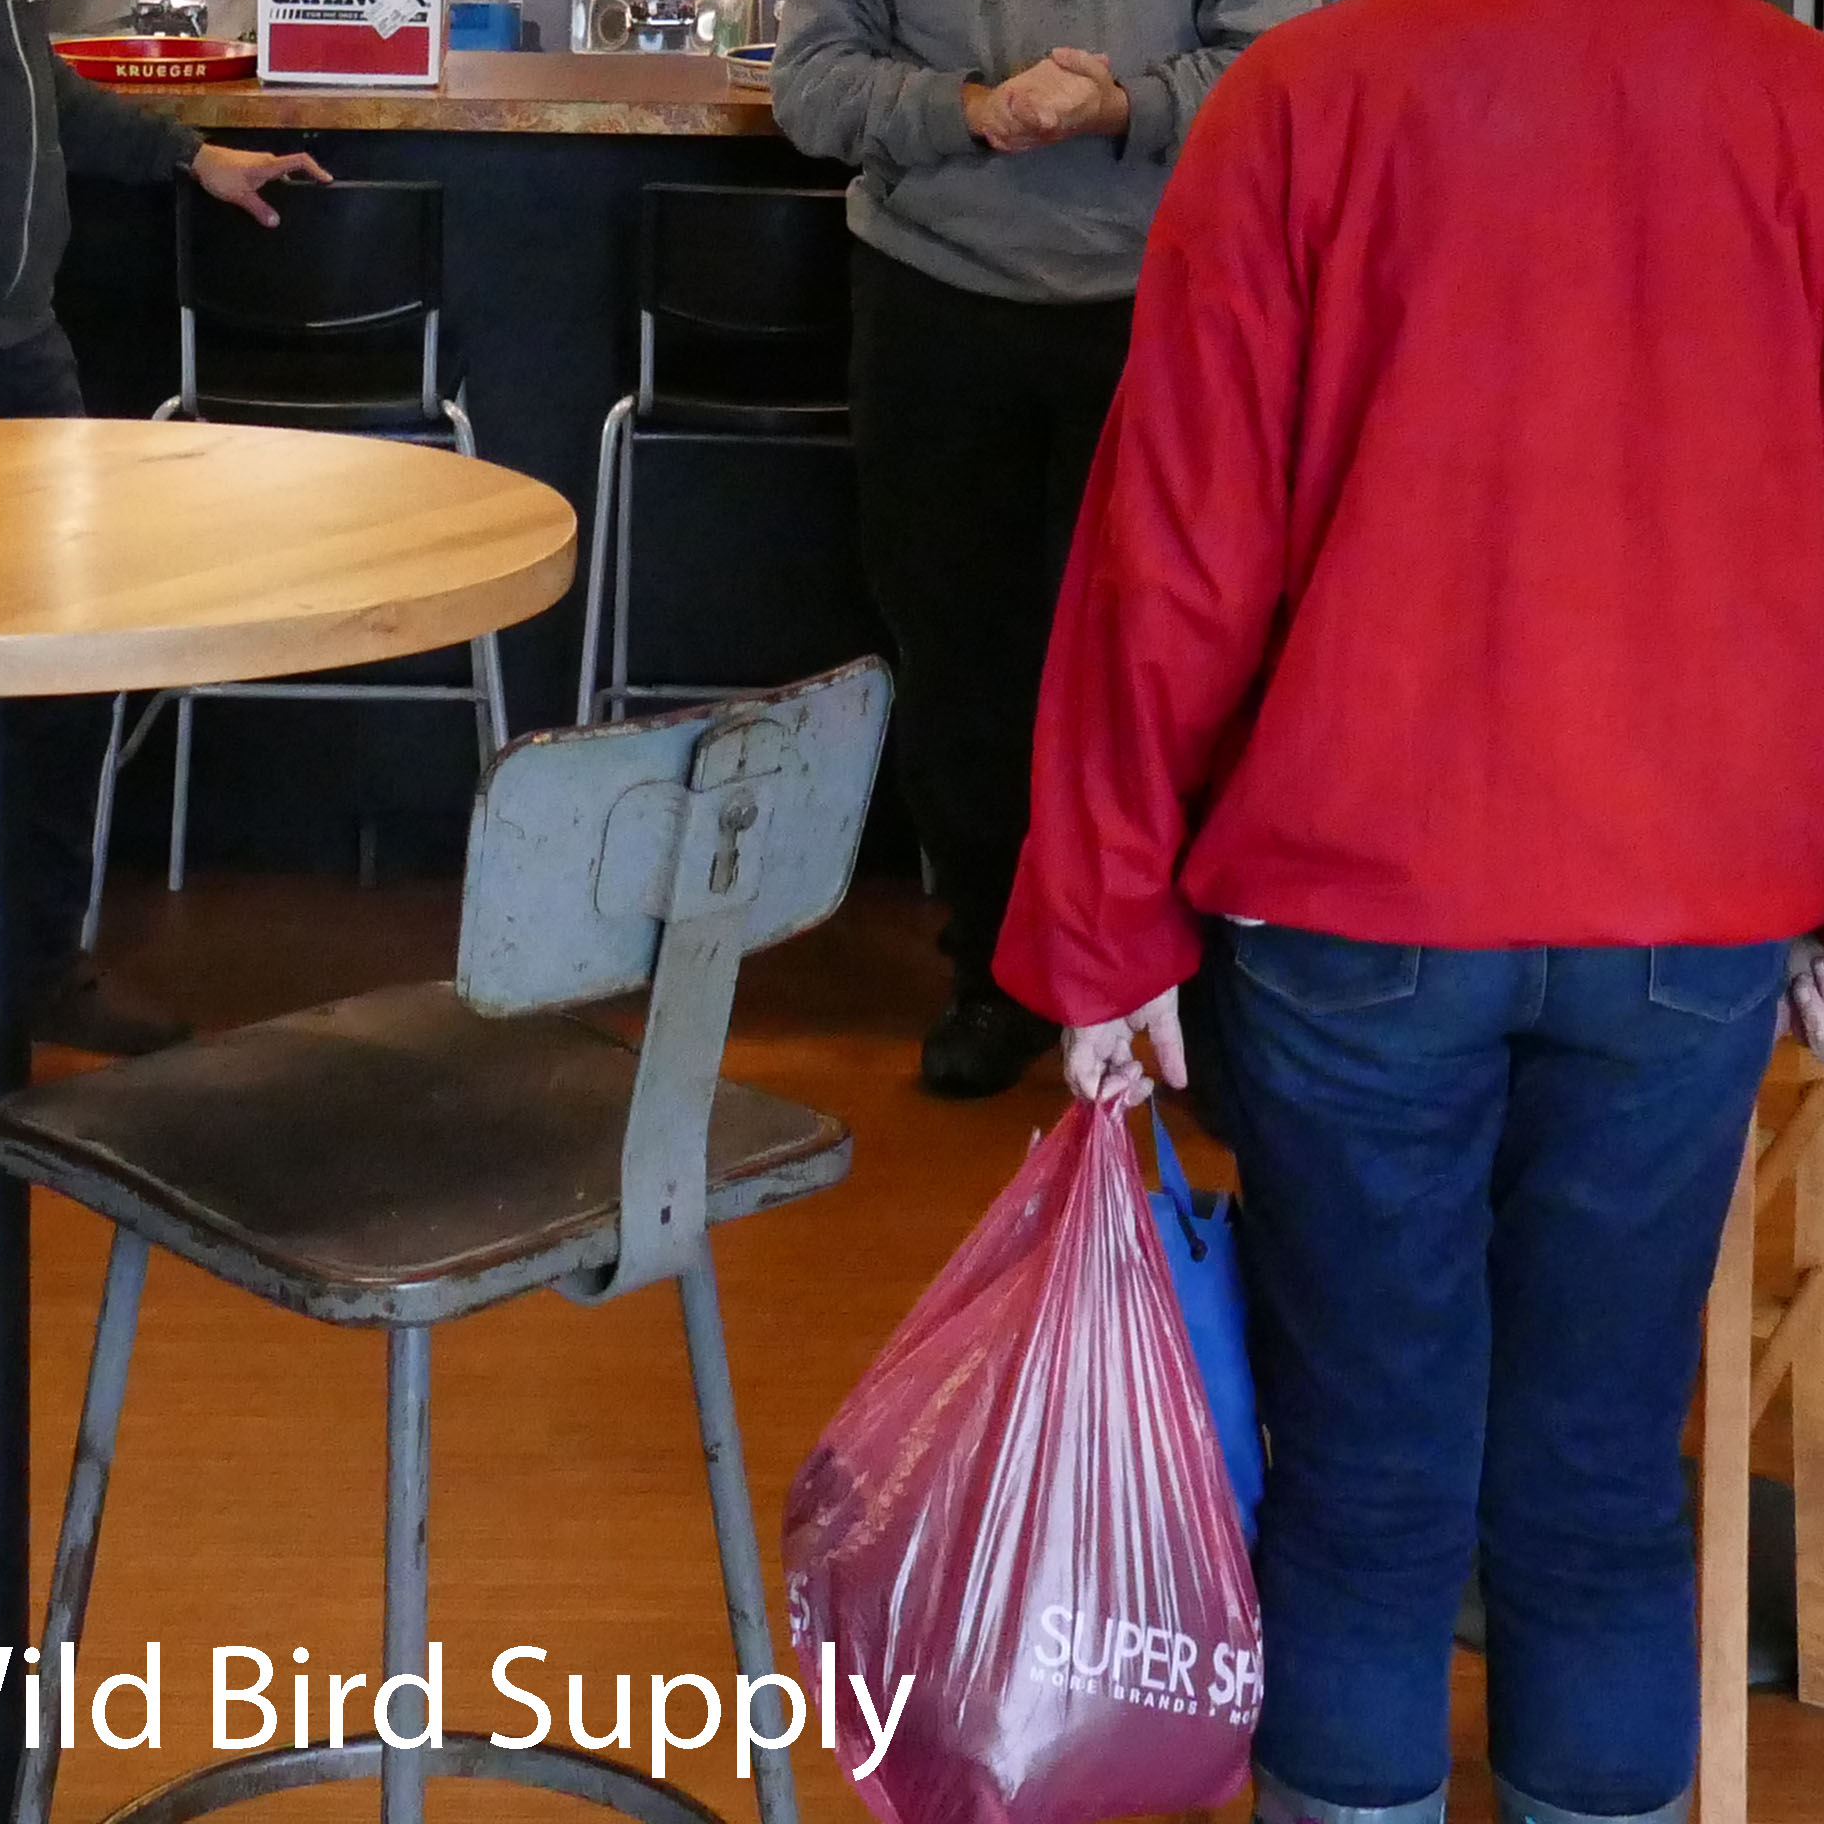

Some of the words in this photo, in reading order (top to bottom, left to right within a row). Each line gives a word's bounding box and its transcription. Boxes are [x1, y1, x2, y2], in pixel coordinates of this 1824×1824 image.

[116, 64, 207, 77] KRUEGER
[1034, 1604, 1197, 1697] SUPER
[1207, 1642, 1264, 1708] SH
[1114, 1683, 1198, 1716] BRANDS
